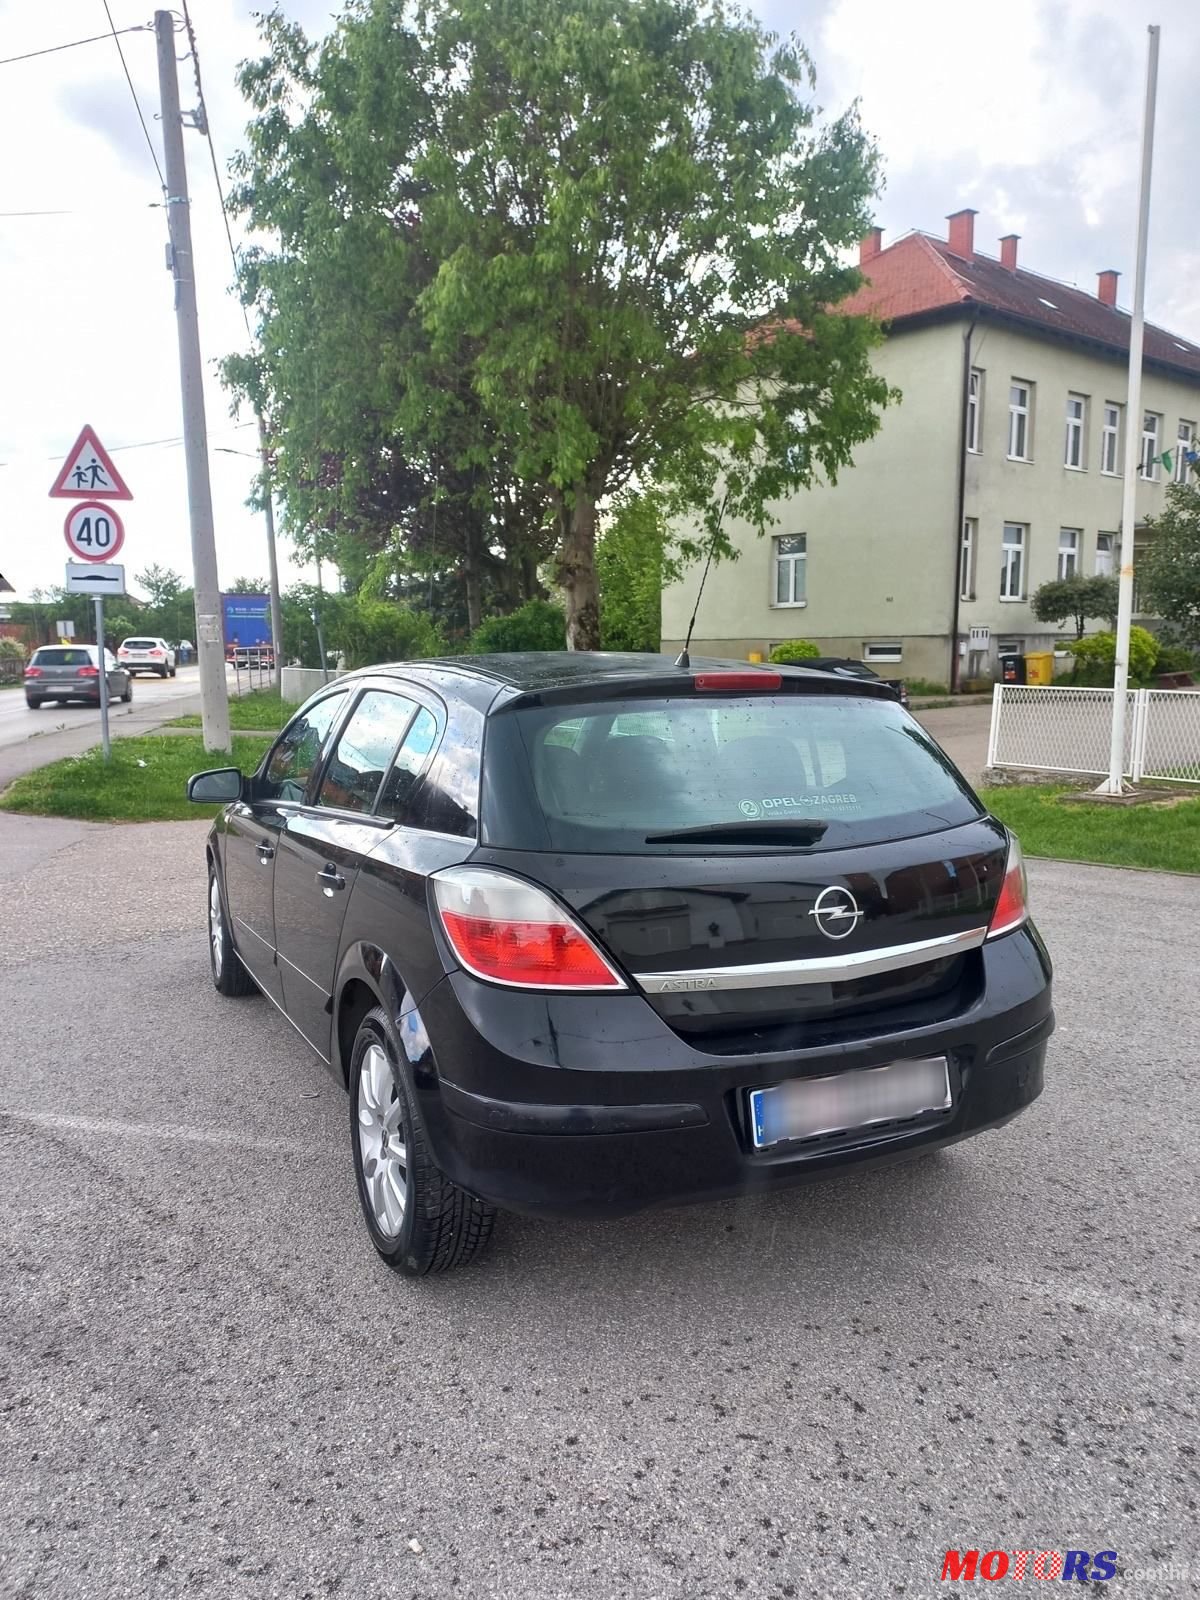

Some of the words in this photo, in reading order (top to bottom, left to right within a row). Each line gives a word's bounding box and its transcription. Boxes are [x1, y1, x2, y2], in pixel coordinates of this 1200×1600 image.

[76, 517, 110, 547] 40
[762, 797, 801, 808] OPEL
[812, 794, 857, 804] ZAGREB
[660, 978, 718, 991] ASTRA
